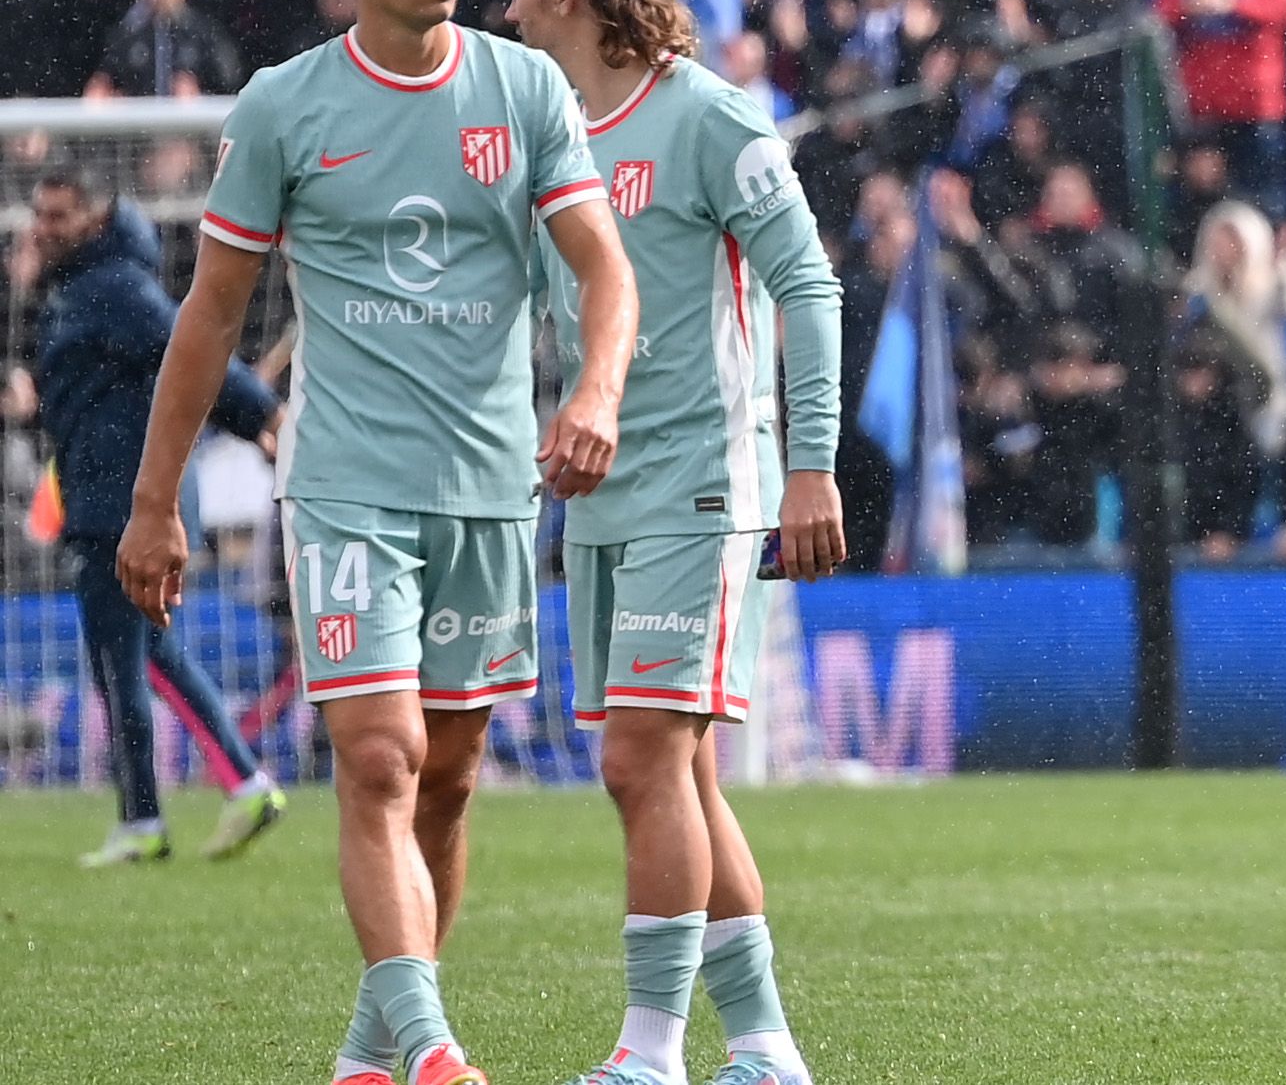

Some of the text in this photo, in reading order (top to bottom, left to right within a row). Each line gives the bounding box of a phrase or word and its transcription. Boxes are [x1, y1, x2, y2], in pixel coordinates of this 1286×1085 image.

[345, 300, 493, 325] RIYADH AIR
[301, 541, 371, 613] 14
[618, 610, 706, 634] ComAve
